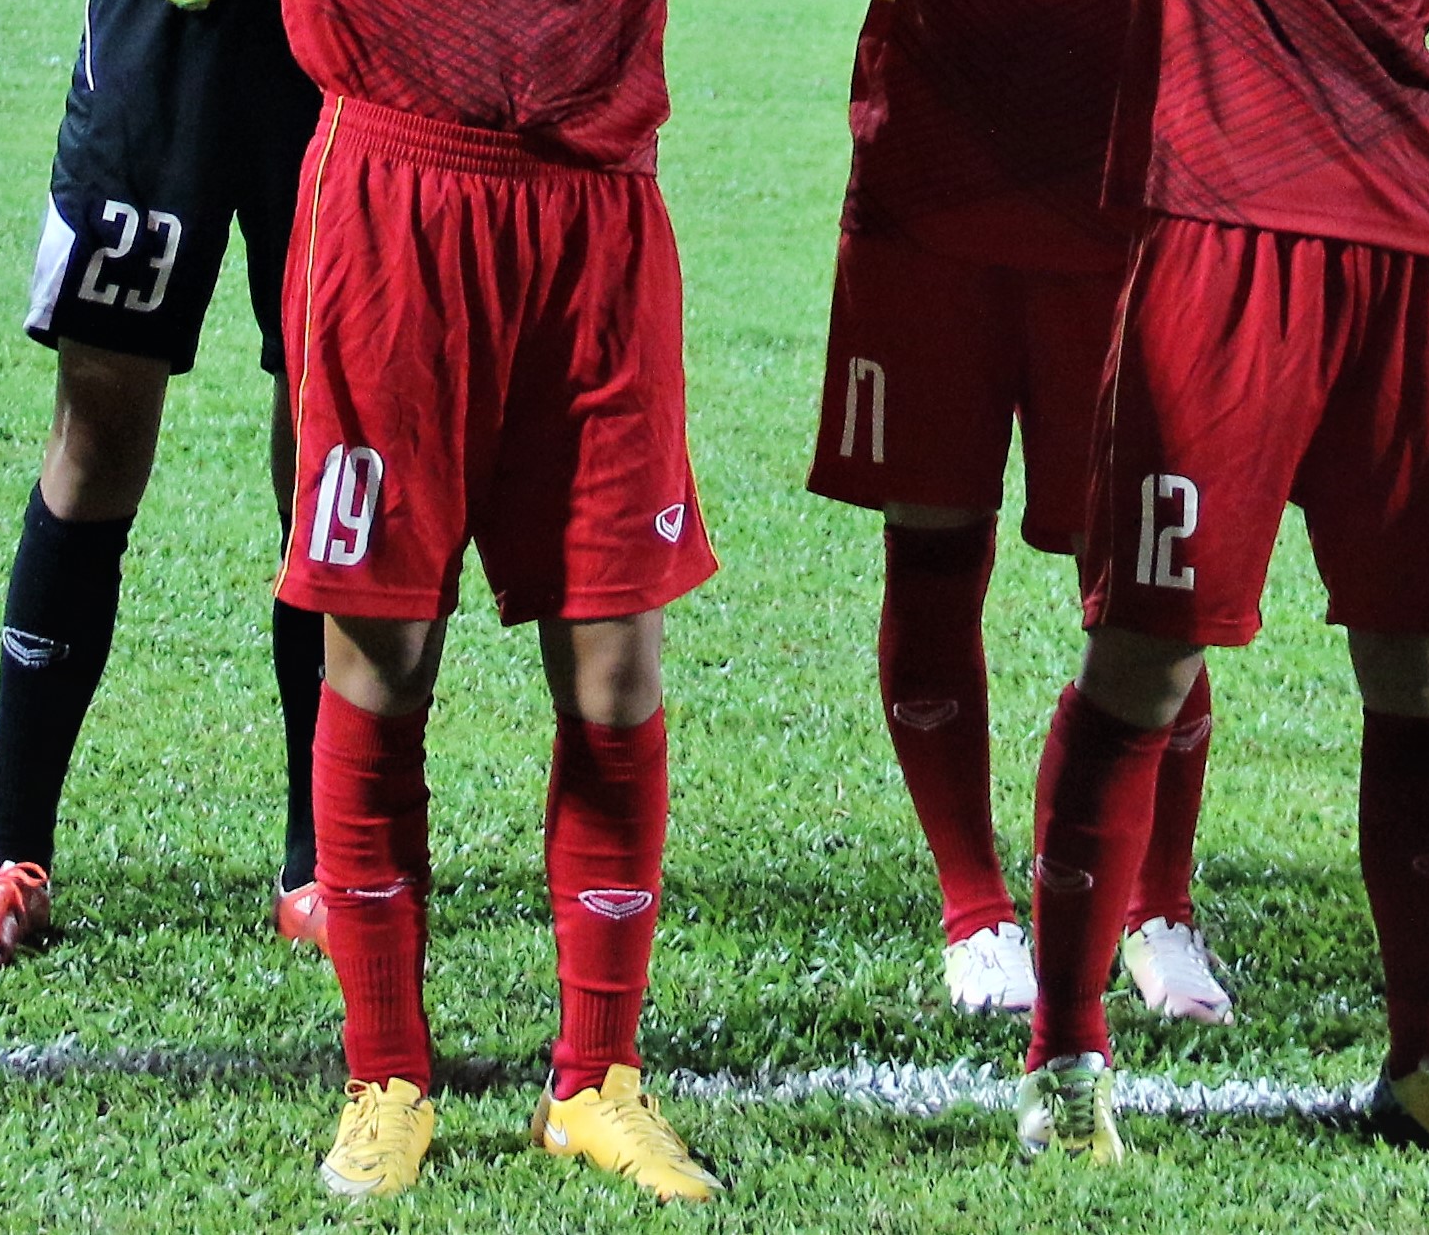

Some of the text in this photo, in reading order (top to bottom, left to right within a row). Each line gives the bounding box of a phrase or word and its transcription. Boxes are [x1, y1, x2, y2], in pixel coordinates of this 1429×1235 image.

[77, 199, 182, 312] 23
[840, 356, 886, 463] 17
[308, 443, 384, 566] 19
[1136, 473, 1199, 590] 12
